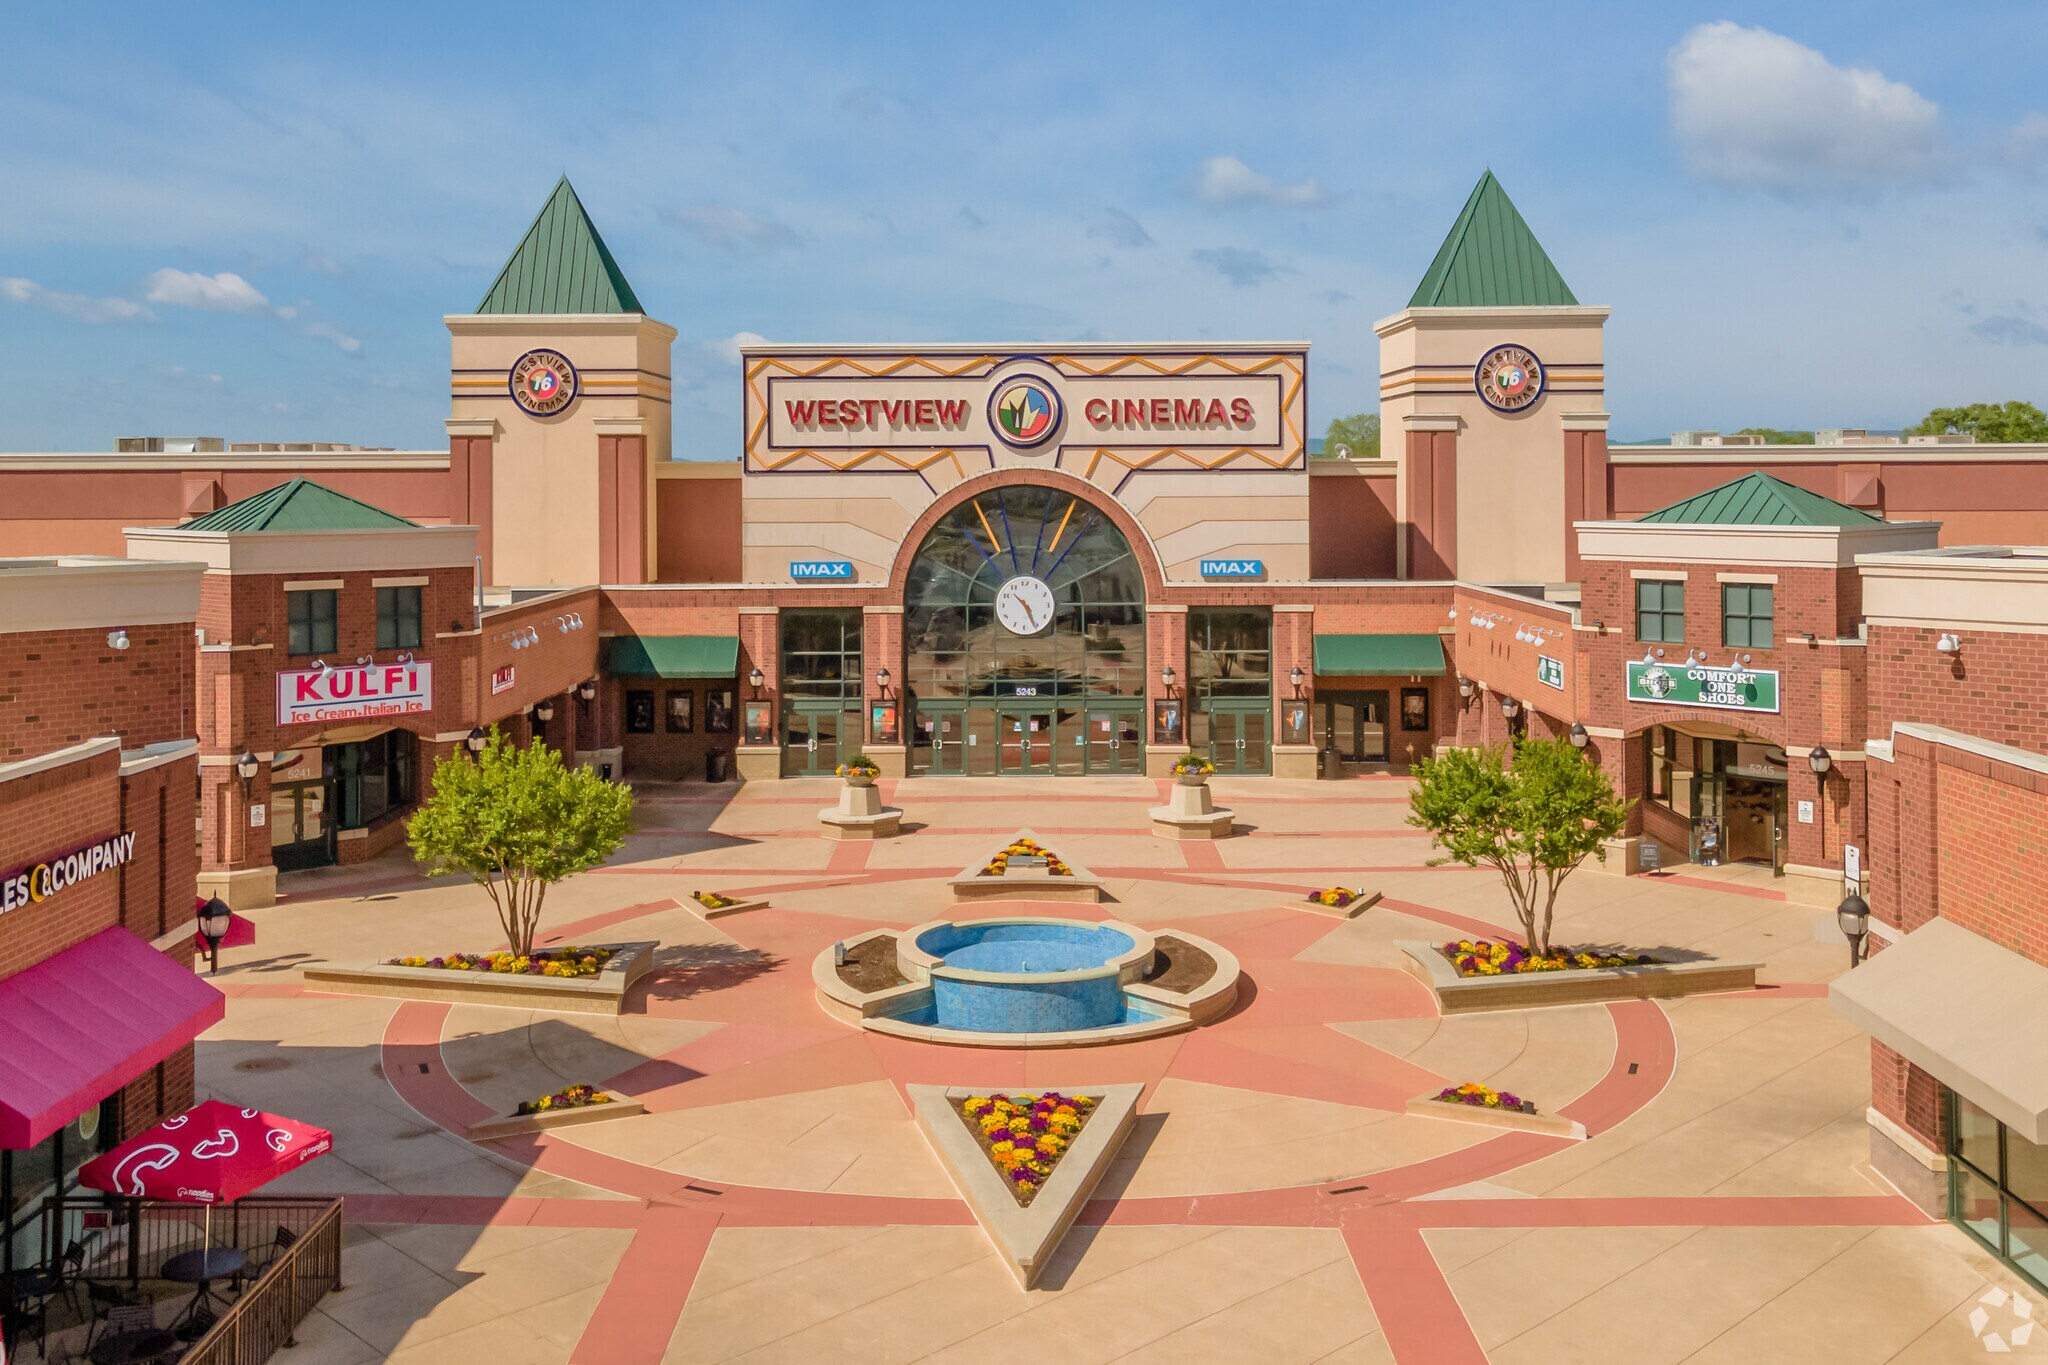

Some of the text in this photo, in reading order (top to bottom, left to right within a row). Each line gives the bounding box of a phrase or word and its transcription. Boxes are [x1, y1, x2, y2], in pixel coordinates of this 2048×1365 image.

[515, 355, 571, 384] WESTVIEW
[1482, 350, 1538, 380] WESTVIEW
[534, 376, 551, 391] 16
[1502, 371, 1520, 386] 16
[518, 390, 568, 411] CINEMAS
[1484, 385, 1536, 407] CINEMAS
[785, 397, 1251, 425] WESTVIEW CINEMAS
[793, 564, 845, 575] IMAX
[1203, 562, 1256, 573] IMAX
[297, 668, 417, 701] KULFI
[1687, 670, 1756, 684] COMFORT
[1015, 688, 1036, 696] 5243
[1707, 681, 1736, 693] ONE
[1698, 692, 1745, 705] SHOES
[292, 711, 311, 723] Ice
[405, 700, 423, 712] Ice
[287, 768, 310, 779] 5241
[1749, 764, 1775, 776] 5245
[52, 831, 136, 892] COMPANY
